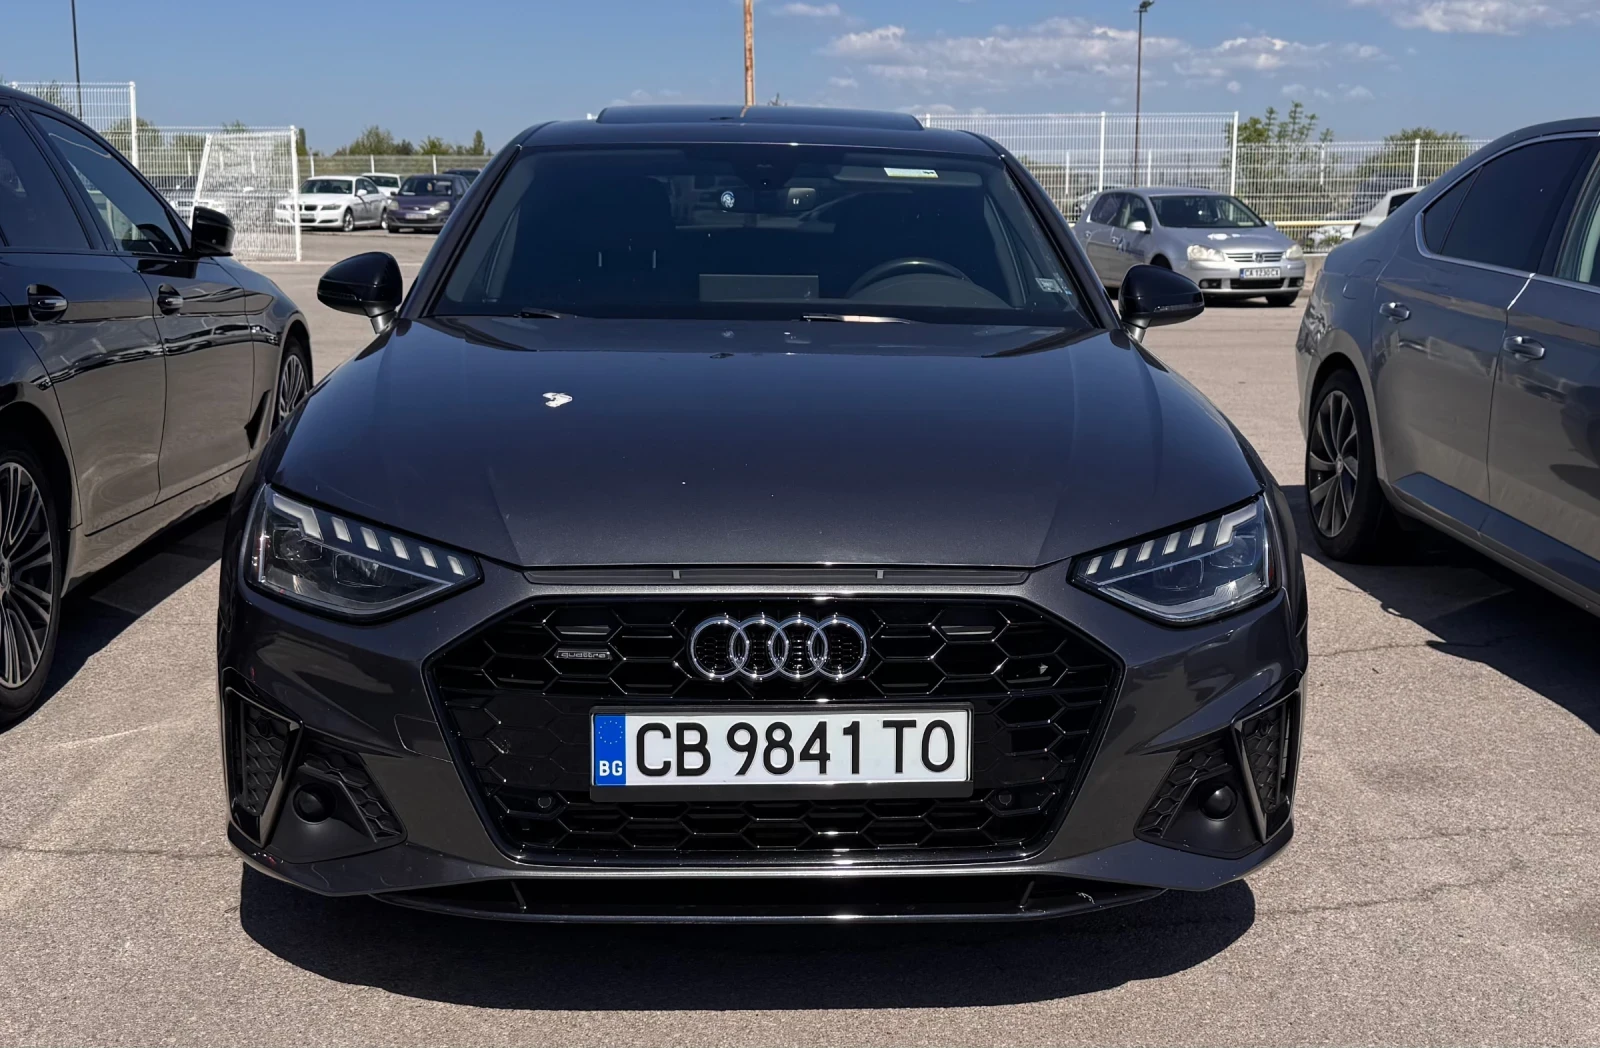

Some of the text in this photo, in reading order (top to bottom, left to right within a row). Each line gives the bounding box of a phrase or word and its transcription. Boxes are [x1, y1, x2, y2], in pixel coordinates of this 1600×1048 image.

[560, 651, 607, 660] quattro
[636, 719, 956, 777] CB 9841 TO
[599, 760, 623, 776] BG
